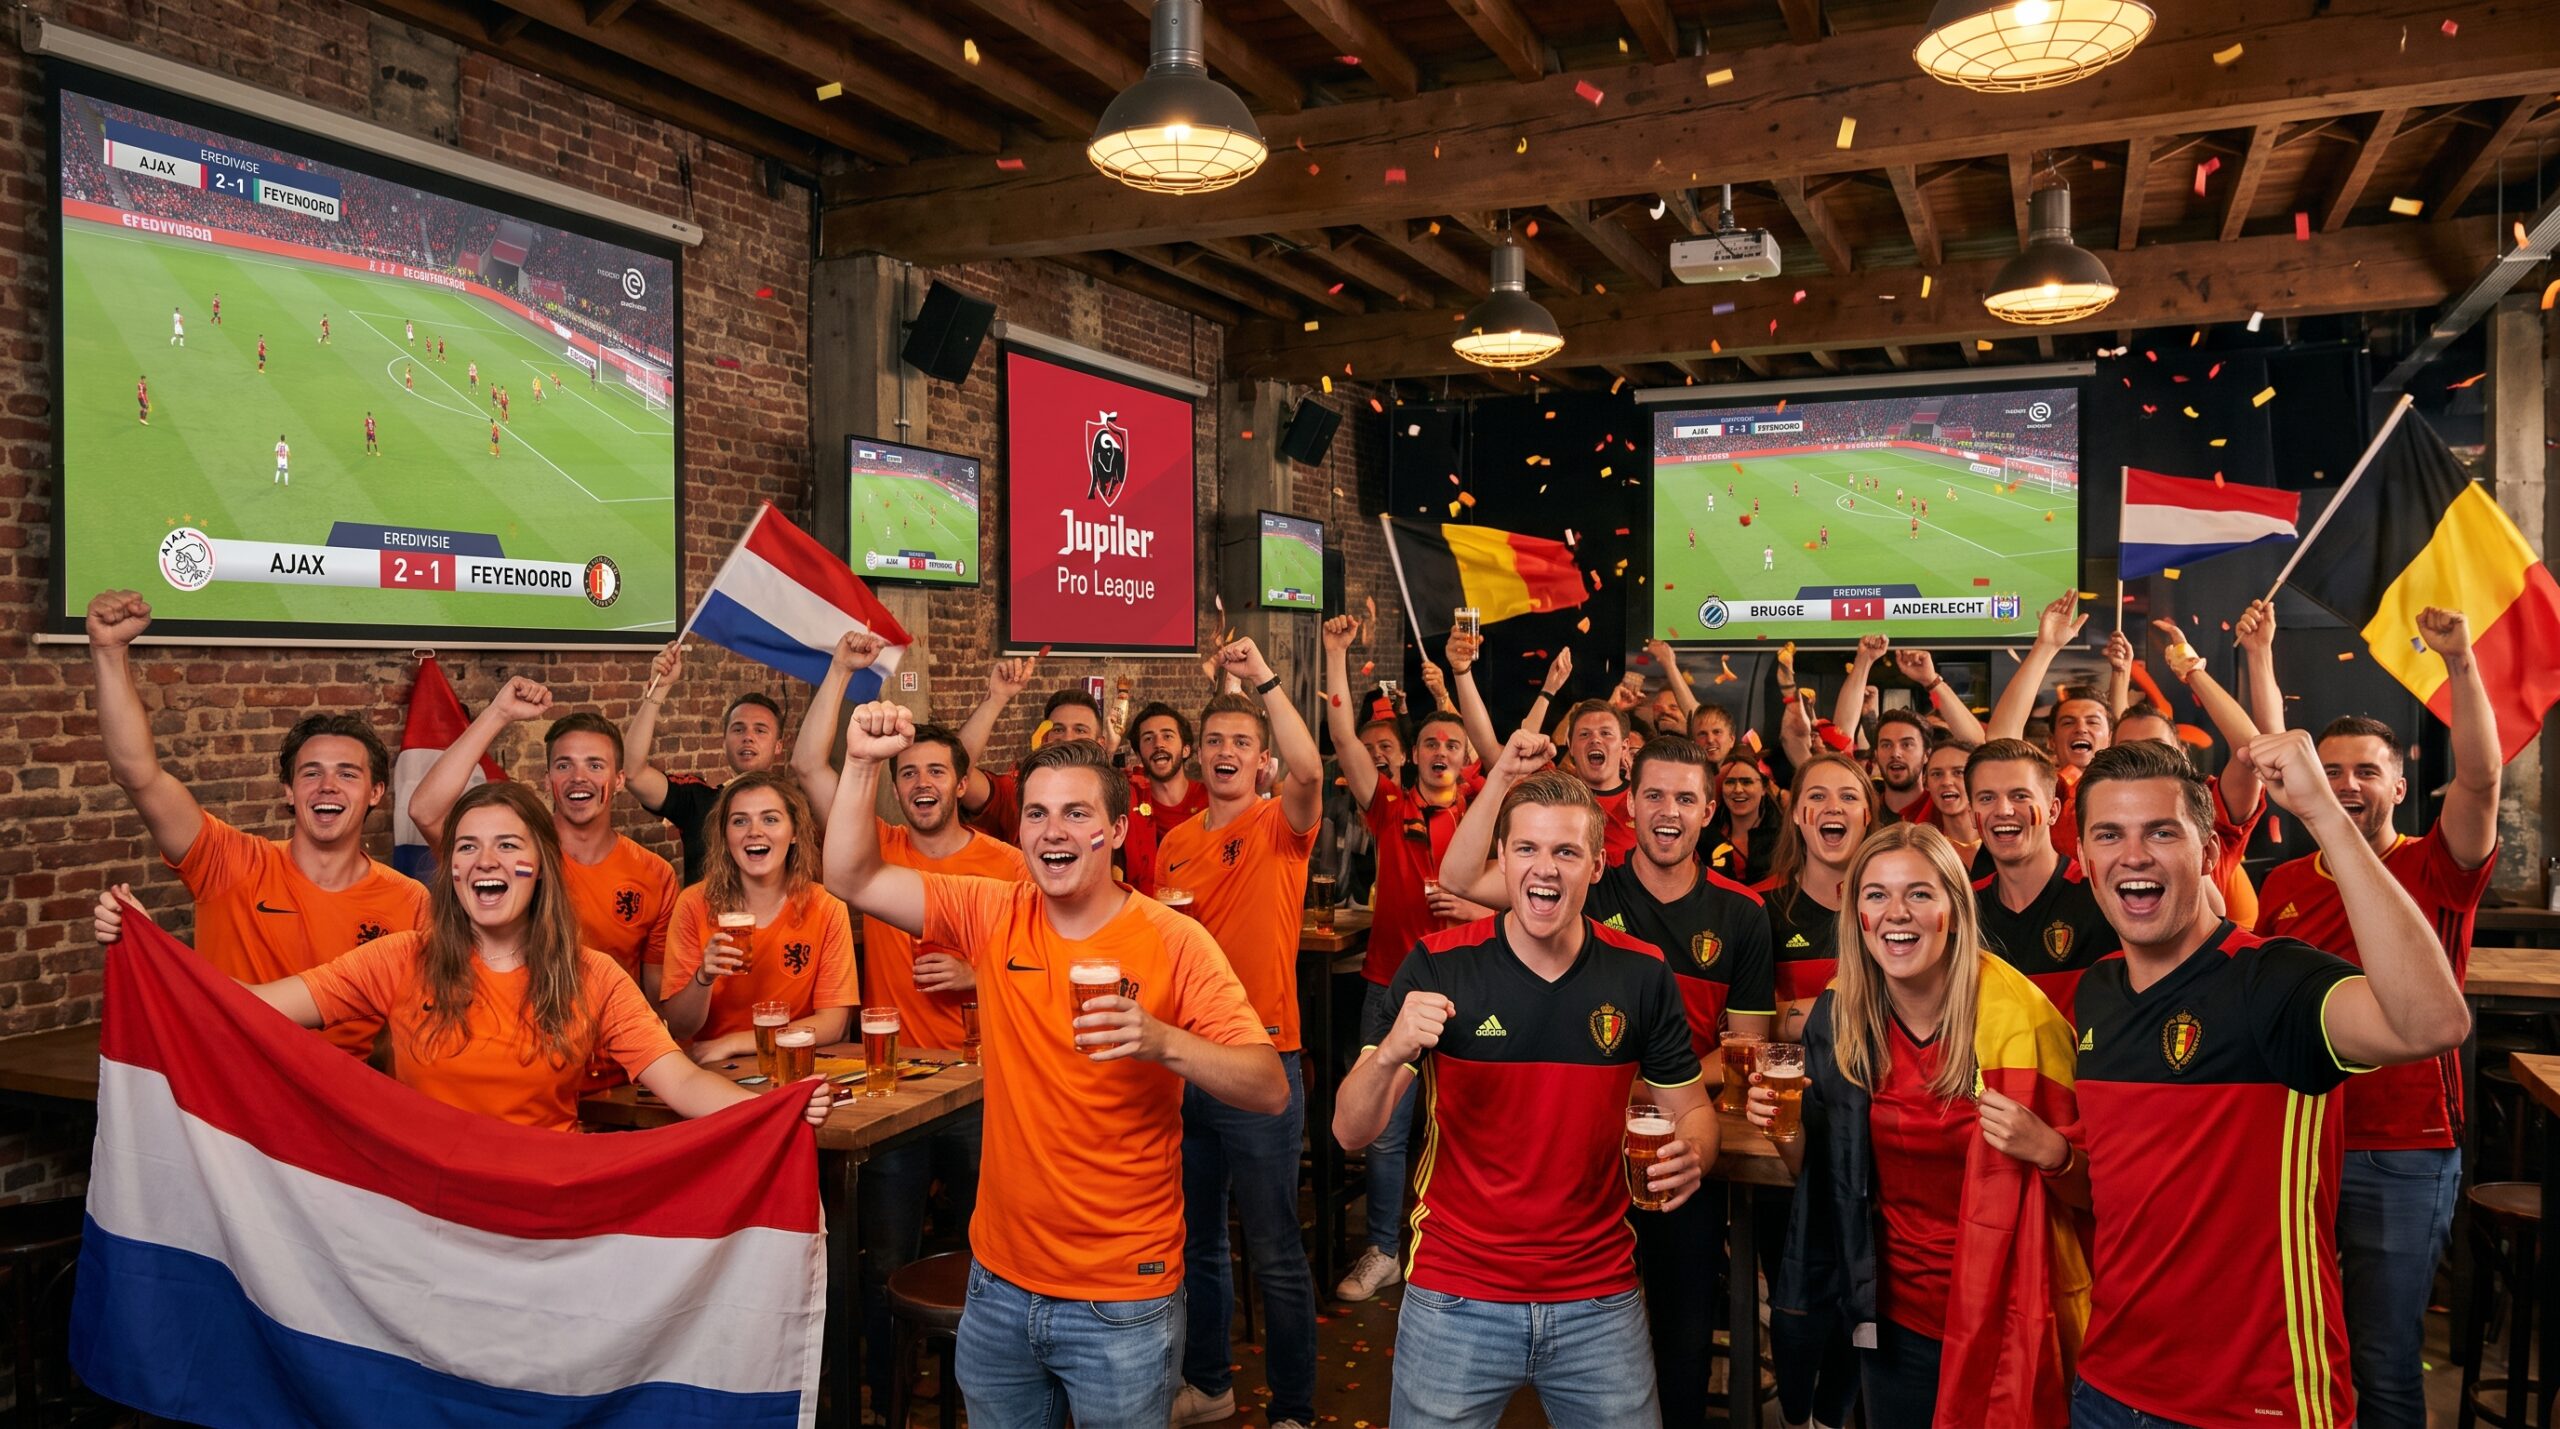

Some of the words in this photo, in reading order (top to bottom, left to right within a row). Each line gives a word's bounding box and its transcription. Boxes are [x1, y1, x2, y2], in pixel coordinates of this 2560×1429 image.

[139, 156, 176, 176] AJAX
[264, 186, 335, 215] FEYENOORD
[161, 530, 187, 556] AJAX
[384, 531, 450, 549] EREDIVISIE
[1058, 508, 1154, 564] Jupiler
[270, 553, 325, 575] AJAX
[471, 565, 572, 589] FEYENOORD
[1057, 566, 1088, 595] Pro
[1094, 569, 1155, 605] League
[1833, 588, 1881, 597] EREDIVISIE
[1751, 605, 1804, 617] BRUGGE
[1892, 602, 1984, 614] ANDERLECHT
